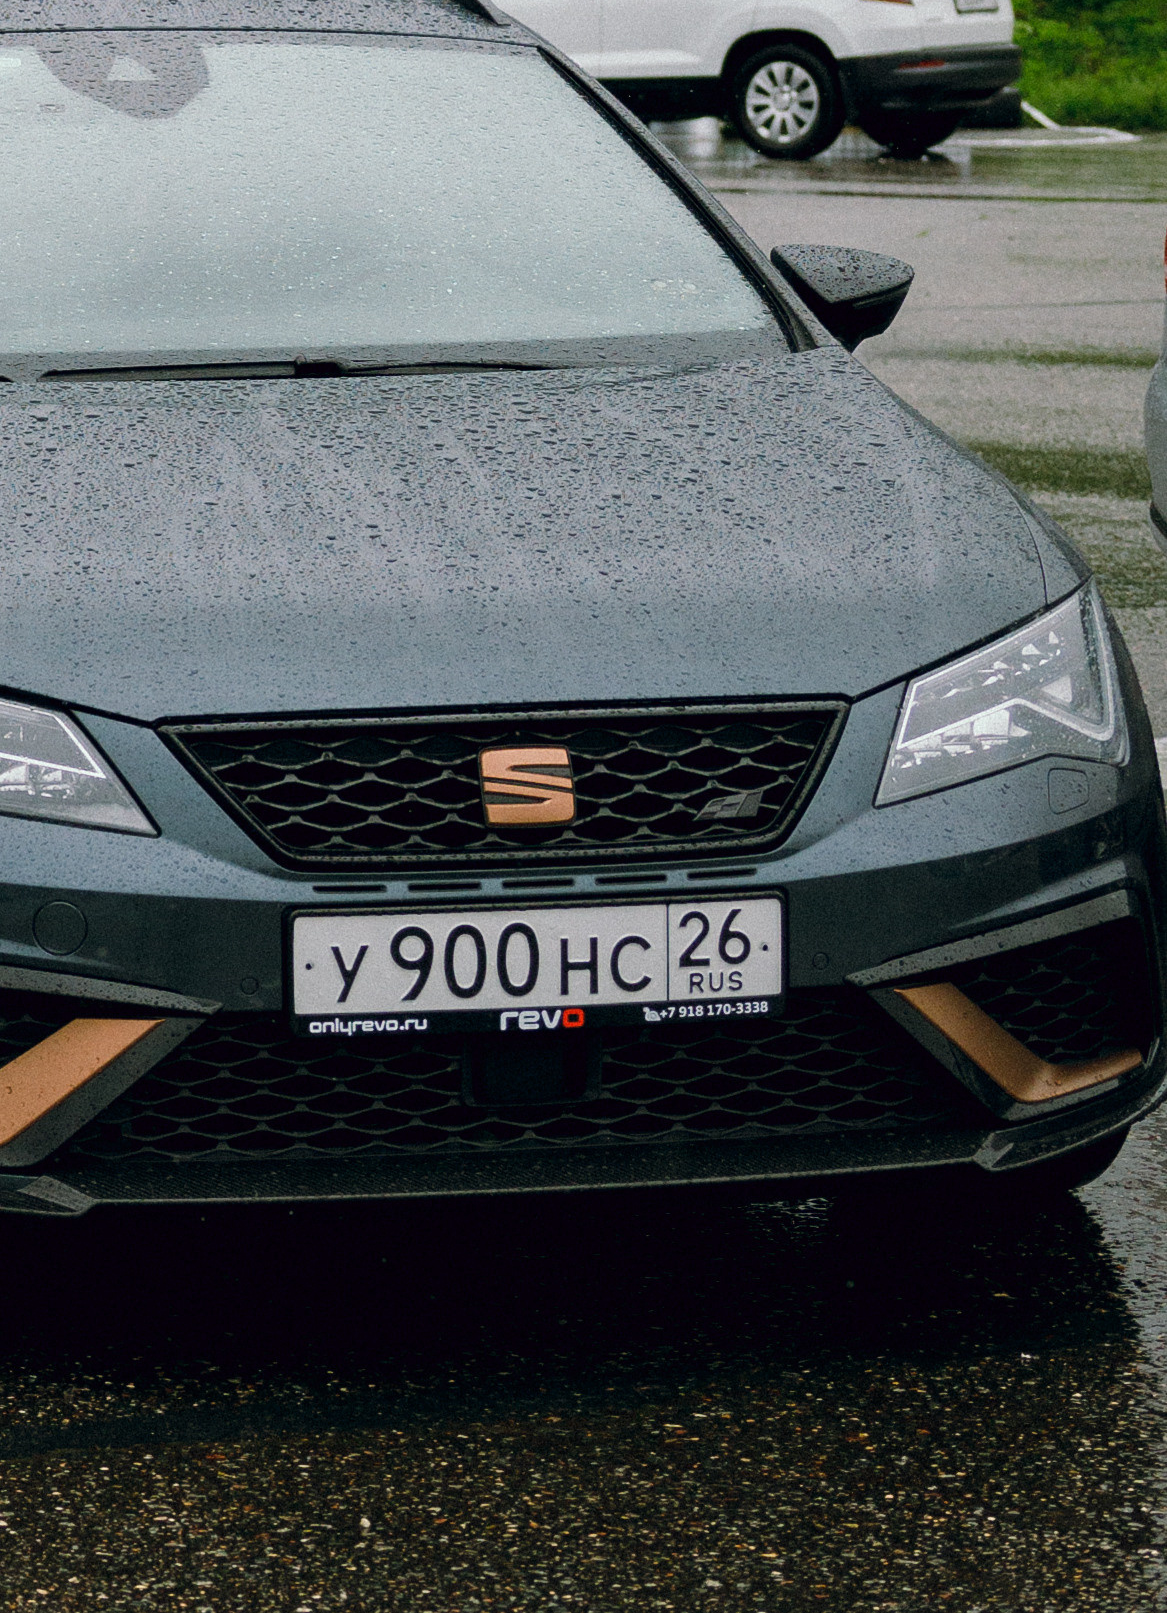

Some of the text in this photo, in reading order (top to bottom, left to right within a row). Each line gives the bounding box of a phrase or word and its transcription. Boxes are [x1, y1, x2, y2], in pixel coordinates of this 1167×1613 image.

[678, 908, 752, 968] 26
[688, 971, 744, 994] RUS
[499, 1008, 586, 1031] revo
[678, 1005, 704, 1018] 918
[707, 1000, 769, 1016] 170-3338
[308, 1017, 428, 1037] onlyrevo.ru
